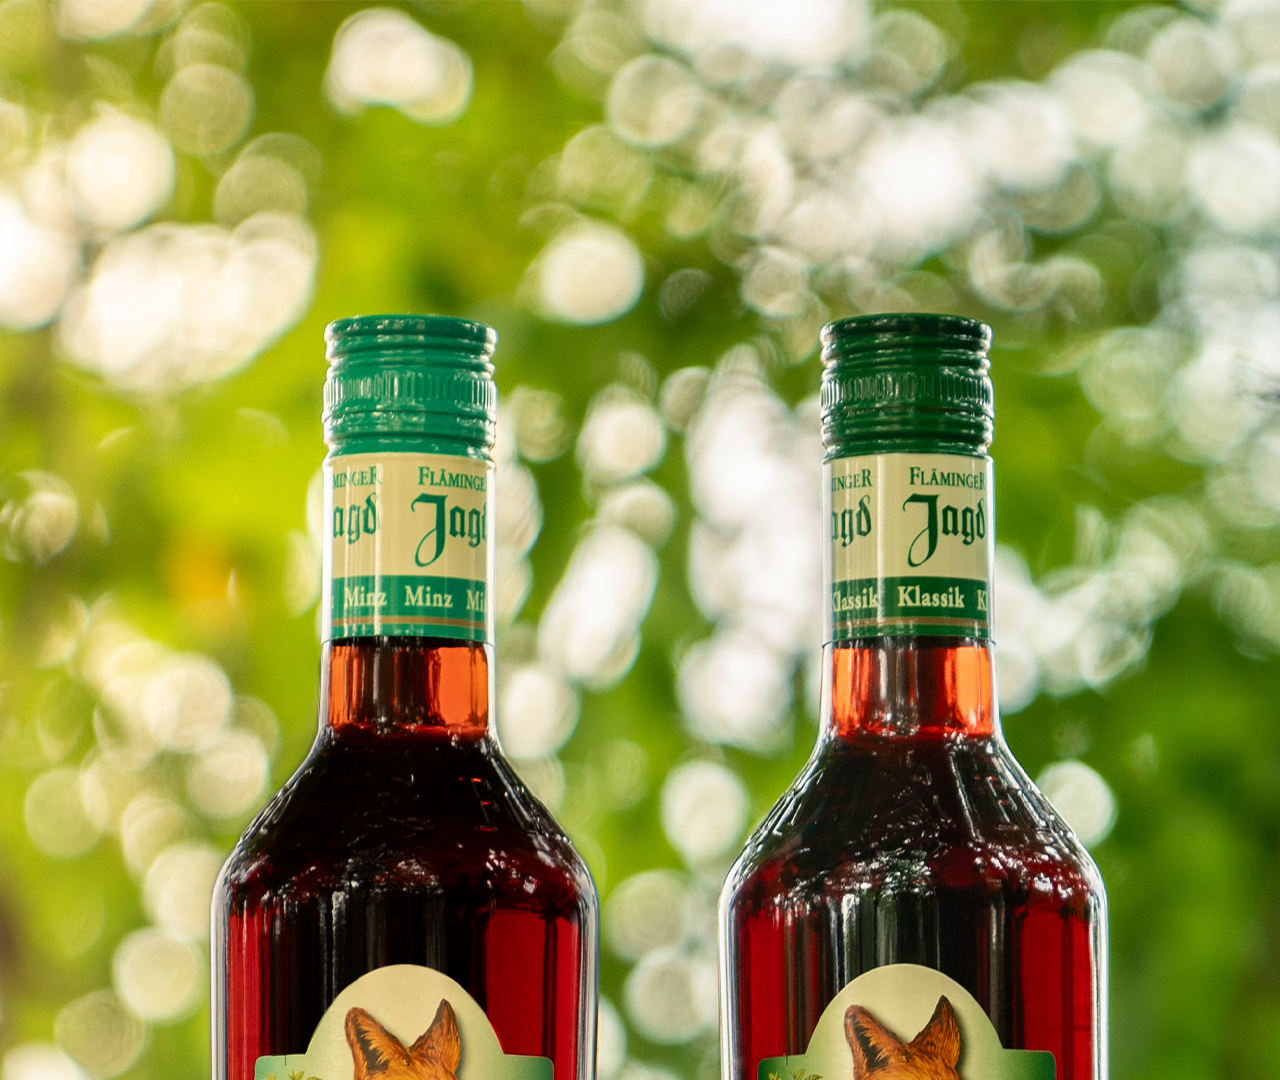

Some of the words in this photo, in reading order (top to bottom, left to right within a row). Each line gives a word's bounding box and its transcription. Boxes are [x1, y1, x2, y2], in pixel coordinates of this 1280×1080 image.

[417, 466, 487, 493] FLÄMINGE
[343, 585, 387, 607] Minz
[404, 585, 454, 608] Minz
[897, 584, 965, 608] Klassik
